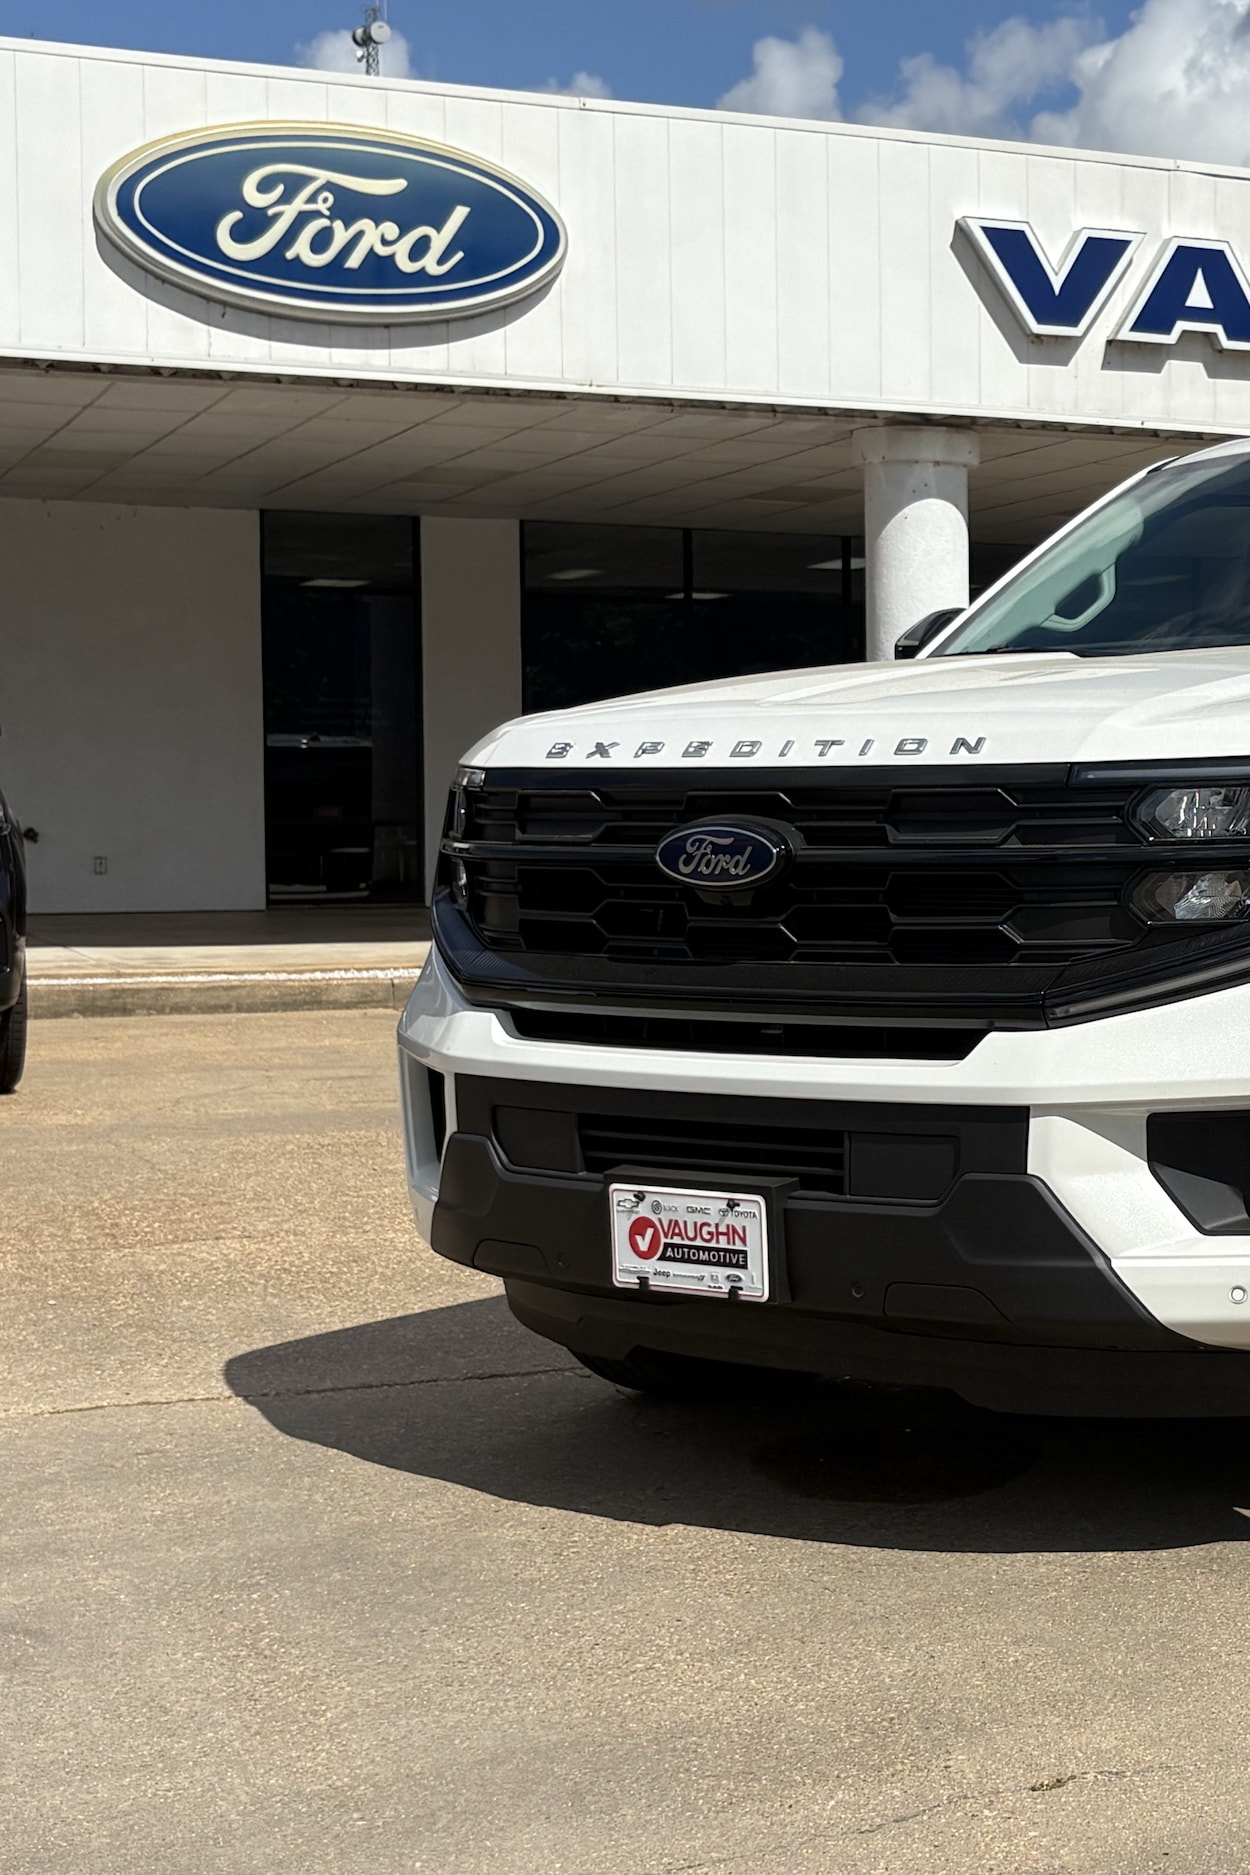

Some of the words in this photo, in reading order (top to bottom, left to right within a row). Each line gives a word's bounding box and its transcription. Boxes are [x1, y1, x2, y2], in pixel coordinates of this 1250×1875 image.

[216, 163, 472, 276] Ford
[545, 737, 987, 759] EXPEDITION
[678, 834, 753, 877] Ford
[686, 1205, 711, 1215] GMC
[731, 1209, 757, 1219] TOYOTA
[657, 1217, 748, 1247] VAUGHN
[665, 1247, 746, 1265] AUTOMOTIVE
[653, 1268, 671, 1278] Jeep
